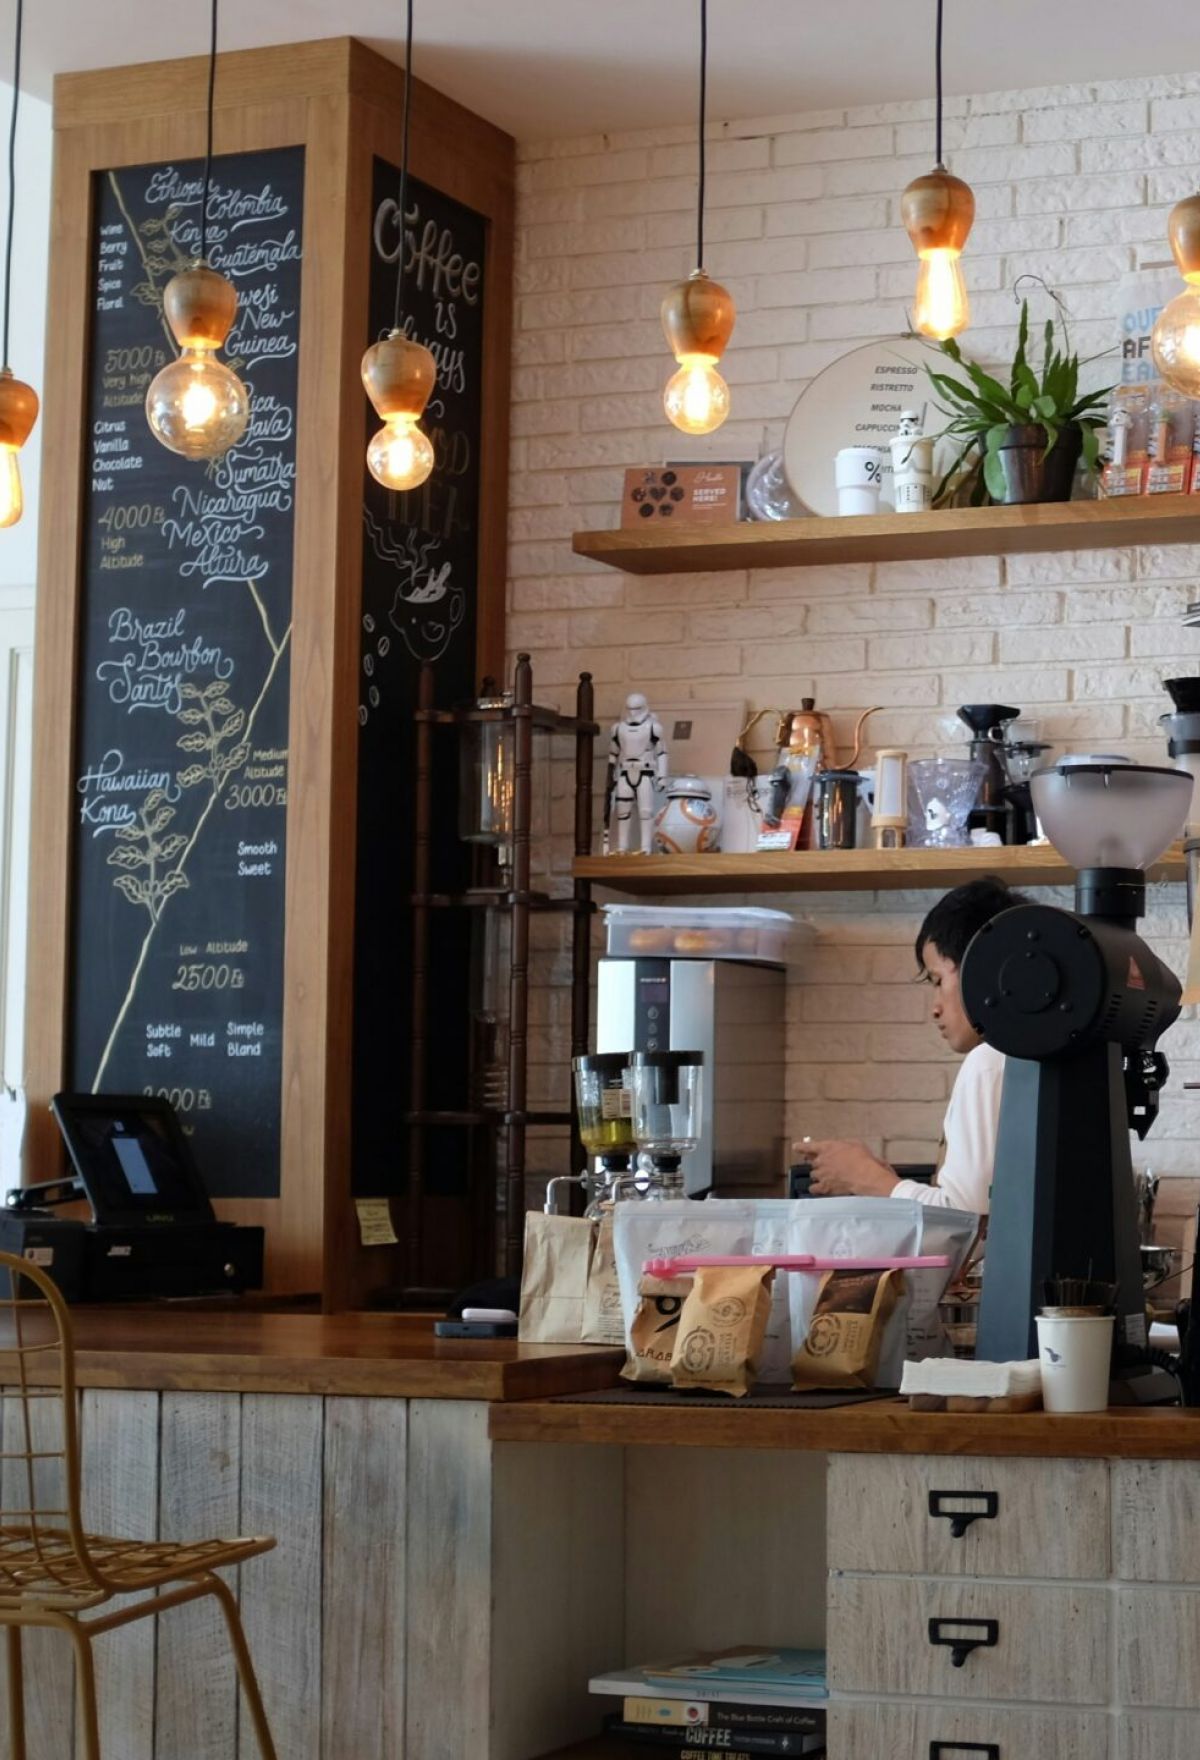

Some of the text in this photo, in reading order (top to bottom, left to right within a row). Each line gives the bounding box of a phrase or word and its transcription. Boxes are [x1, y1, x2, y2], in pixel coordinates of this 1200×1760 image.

[206, 184, 288, 226] Colombia
[100, 240, 127, 255] Berry
[207, 229, 302, 274] Guatemala
[373, 197, 481, 306] Coffee
[98, 259, 124, 271] Fruit
[98, 279, 122, 291] Spice
[97, 296, 124, 310] Floral
[240, 307, 295, 331] New
[434, 301, 458, 340] is
[104, 345, 153, 374] 5000
[224, 331, 296, 369] Guinea
[875, 366, 918, 375] ESPRESSO
[870, 384, 914, 392] RISTRETTO
[871, 404, 902, 412] MOCHA
[94, 420, 126, 435] Citrus
[94, 437, 129, 454] Vanilla
[92, 454, 143, 473] Chocolate
[215, 446, 297, 493] Sumatra
[92, 477, 114, 492] Nut
[172, 485, 292, 525] Nicaragua
[97, 503, 151, 533] 4000
[161, 519, 265, 550] Mexico
[100, 537, 125, 554] High
[99, 553, 144, 570] Altitude
[179, 543, 269, 590] Altura
[108, 607, 186, 647] Brazil
[136, 636, 235, 680] Bourbon
[96, 652, 182, 715] Santos
[77, 749, 182, 803] Hawaiian
[243, 763, 285, 780] Altitude
[224, 784, 275, 810] 3000
[80, 795, 137, 838] Kona
[237, 840, 278, 856] Smooth
[237, 861, 273, 877] Sweet
[205, 939, 249, 955] Altitude
[171, 963, 229, 991] 2500
[146, 1023, 182, 1039] Subtle
[226, 1020, 265, 1039] Simple
[189, 1032, 216, 1048] Mild
[227, 1042, 262, 1057] Bland
[146, 1043, 172, 1058] Soft
[685, 1727, 731, 1746] COFFEE
